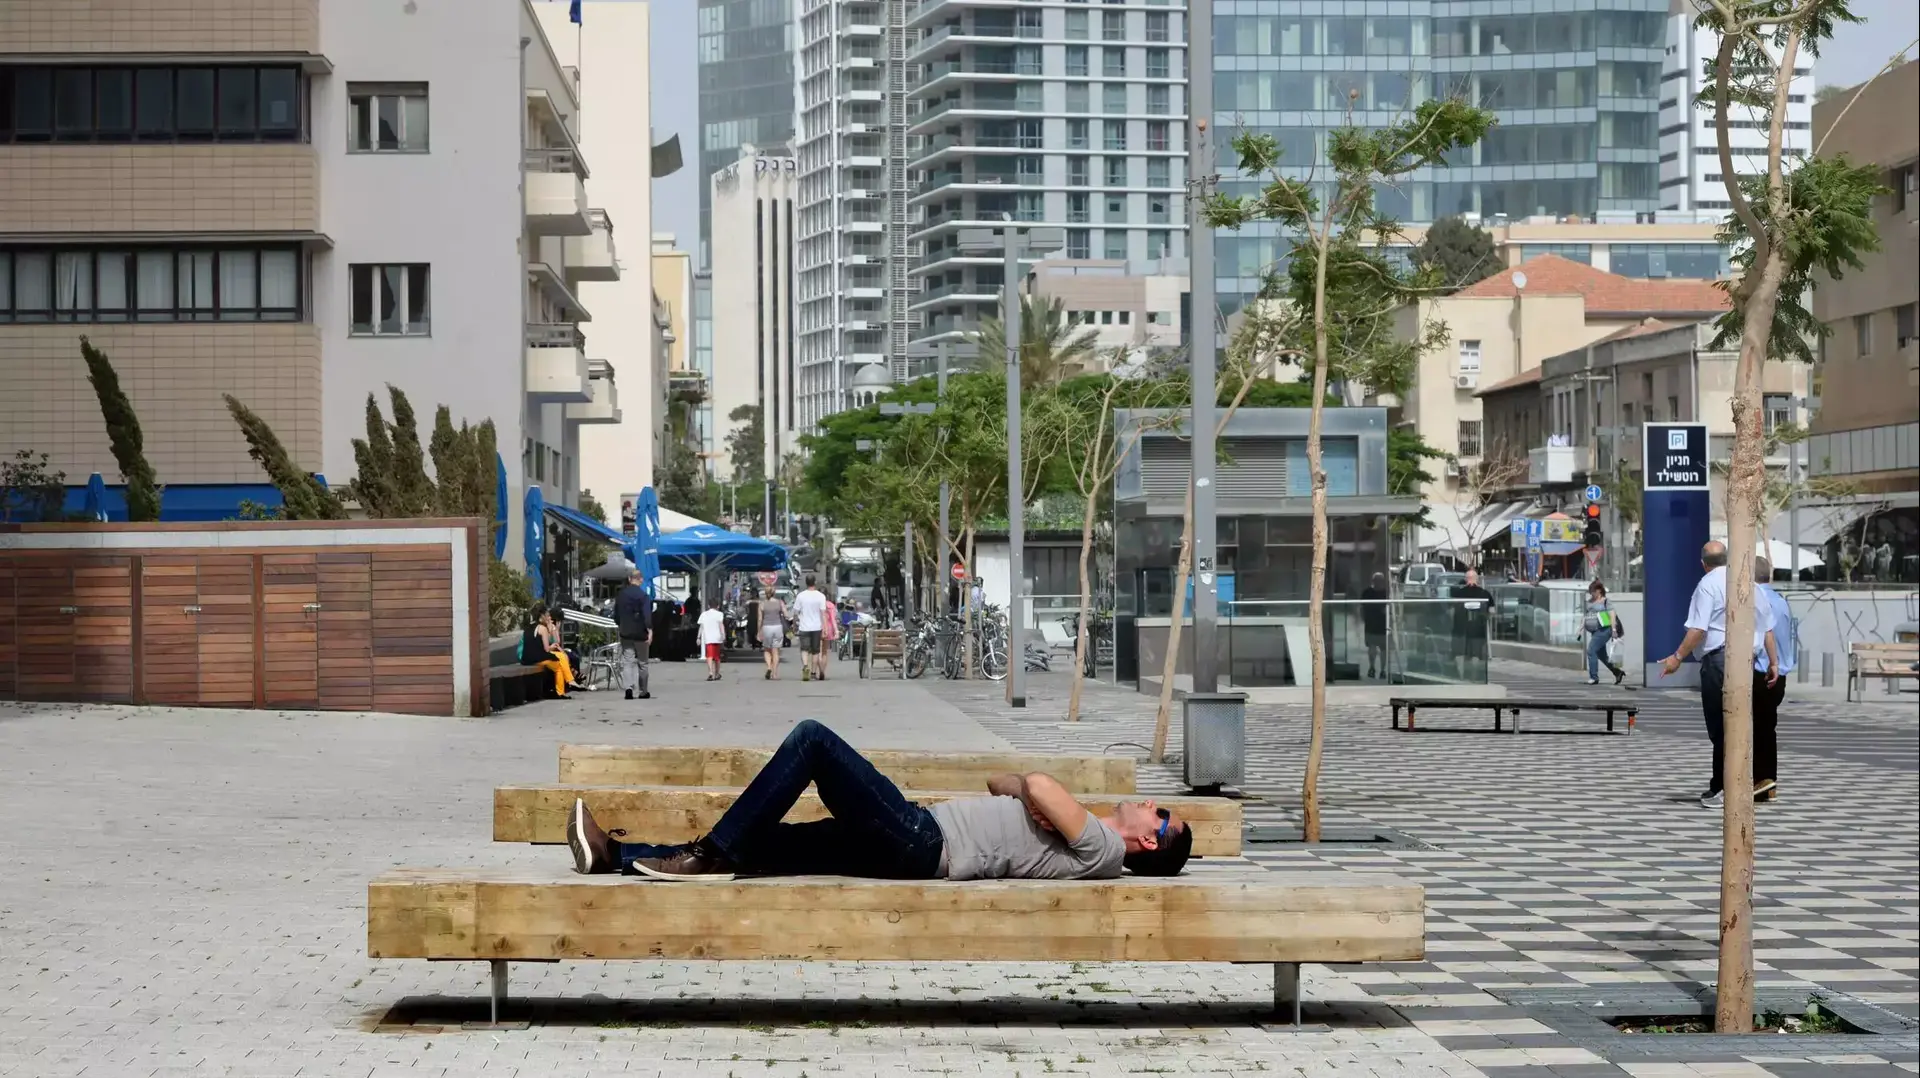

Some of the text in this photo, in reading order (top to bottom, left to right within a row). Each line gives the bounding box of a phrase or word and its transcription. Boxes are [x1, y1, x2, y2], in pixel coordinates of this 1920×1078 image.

[755, 159, 795, 173] בנק
[1666, 455, 1690, 469] חניון
[1656, 468, 1699, 482] רוטשילד
